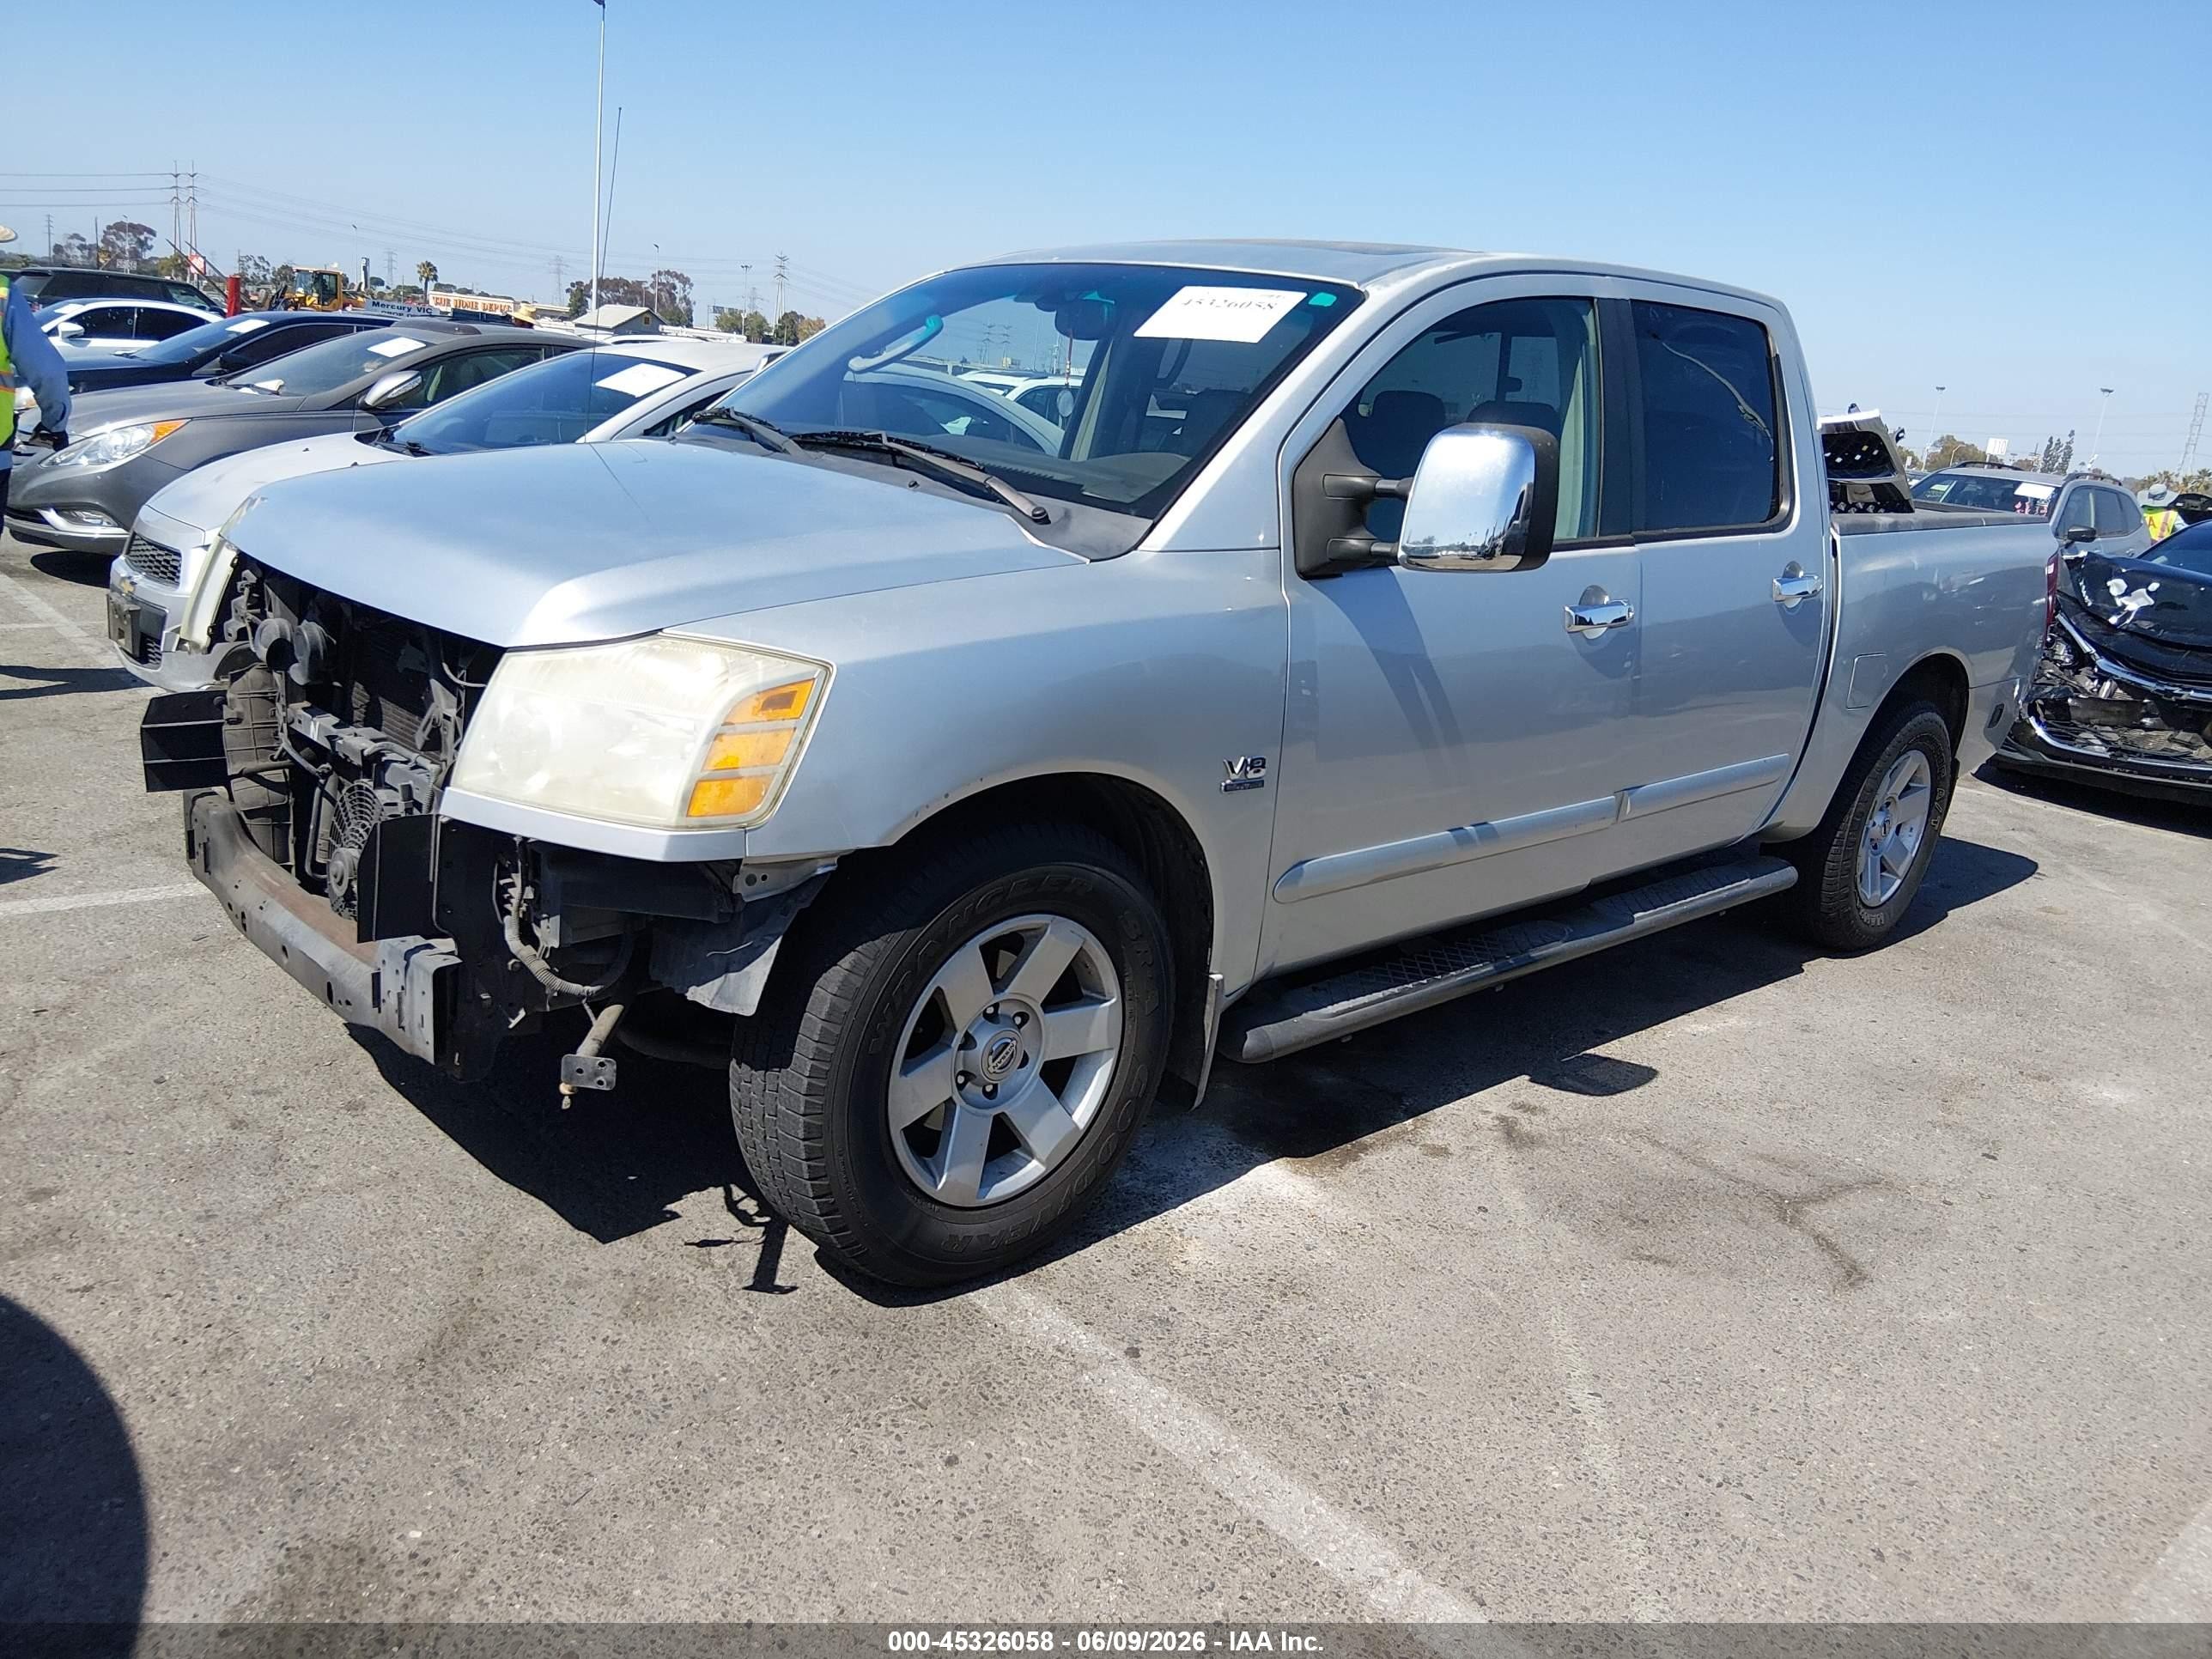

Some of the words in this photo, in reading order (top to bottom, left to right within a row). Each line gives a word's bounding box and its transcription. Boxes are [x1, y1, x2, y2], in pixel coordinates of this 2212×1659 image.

[372, 301, 412, 313] Mercury
[416, 306, 433, 314] VIC
[1222, 756, 1266, 780] V8
[988, 1039, 1018, 1073] NISSAN
[939, 1063, 1149, 1255] GOODYEAR
